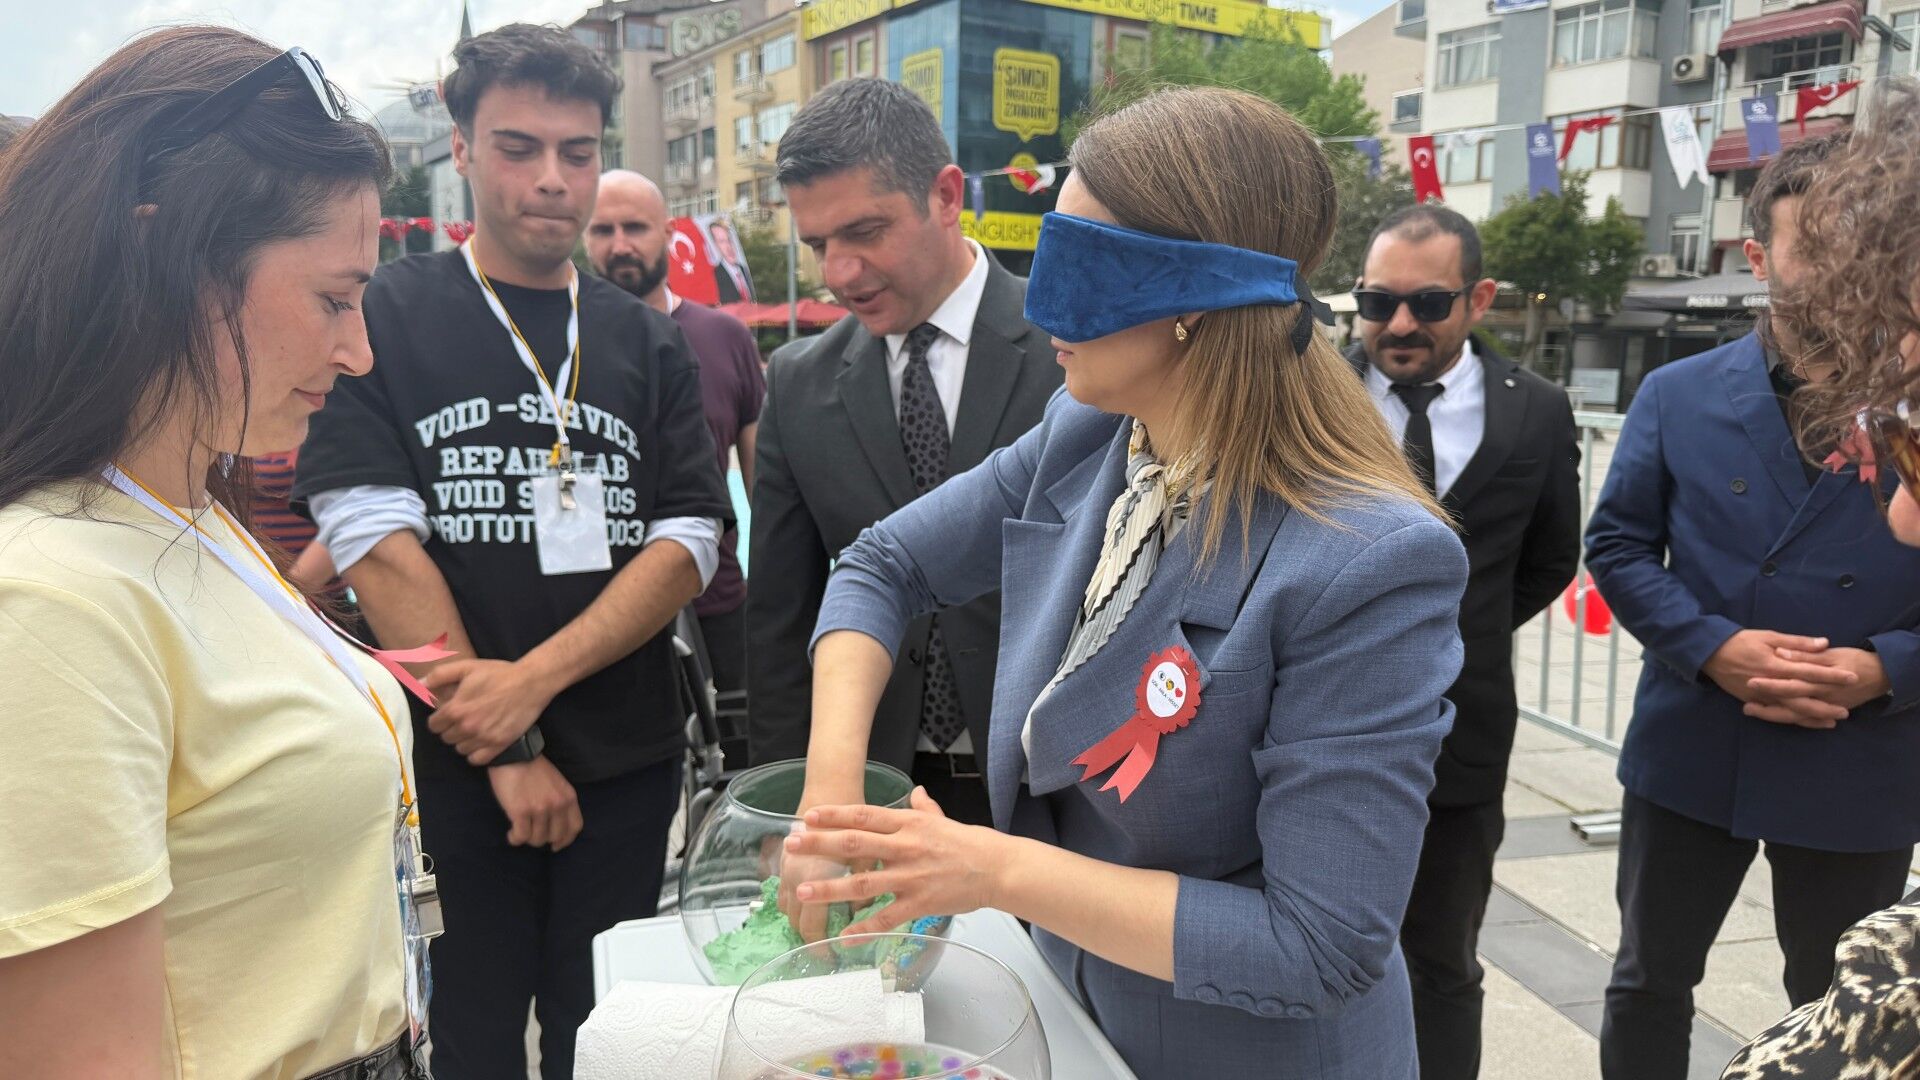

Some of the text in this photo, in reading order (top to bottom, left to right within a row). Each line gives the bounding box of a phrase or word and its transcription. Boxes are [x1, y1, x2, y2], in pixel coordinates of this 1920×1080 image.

[1179, 3, 1216, 24] TIME
[415, 397, 491, 448] VOID
[571, 450, 630, 482] LAB
[432, 479, 506, 511] VOID
